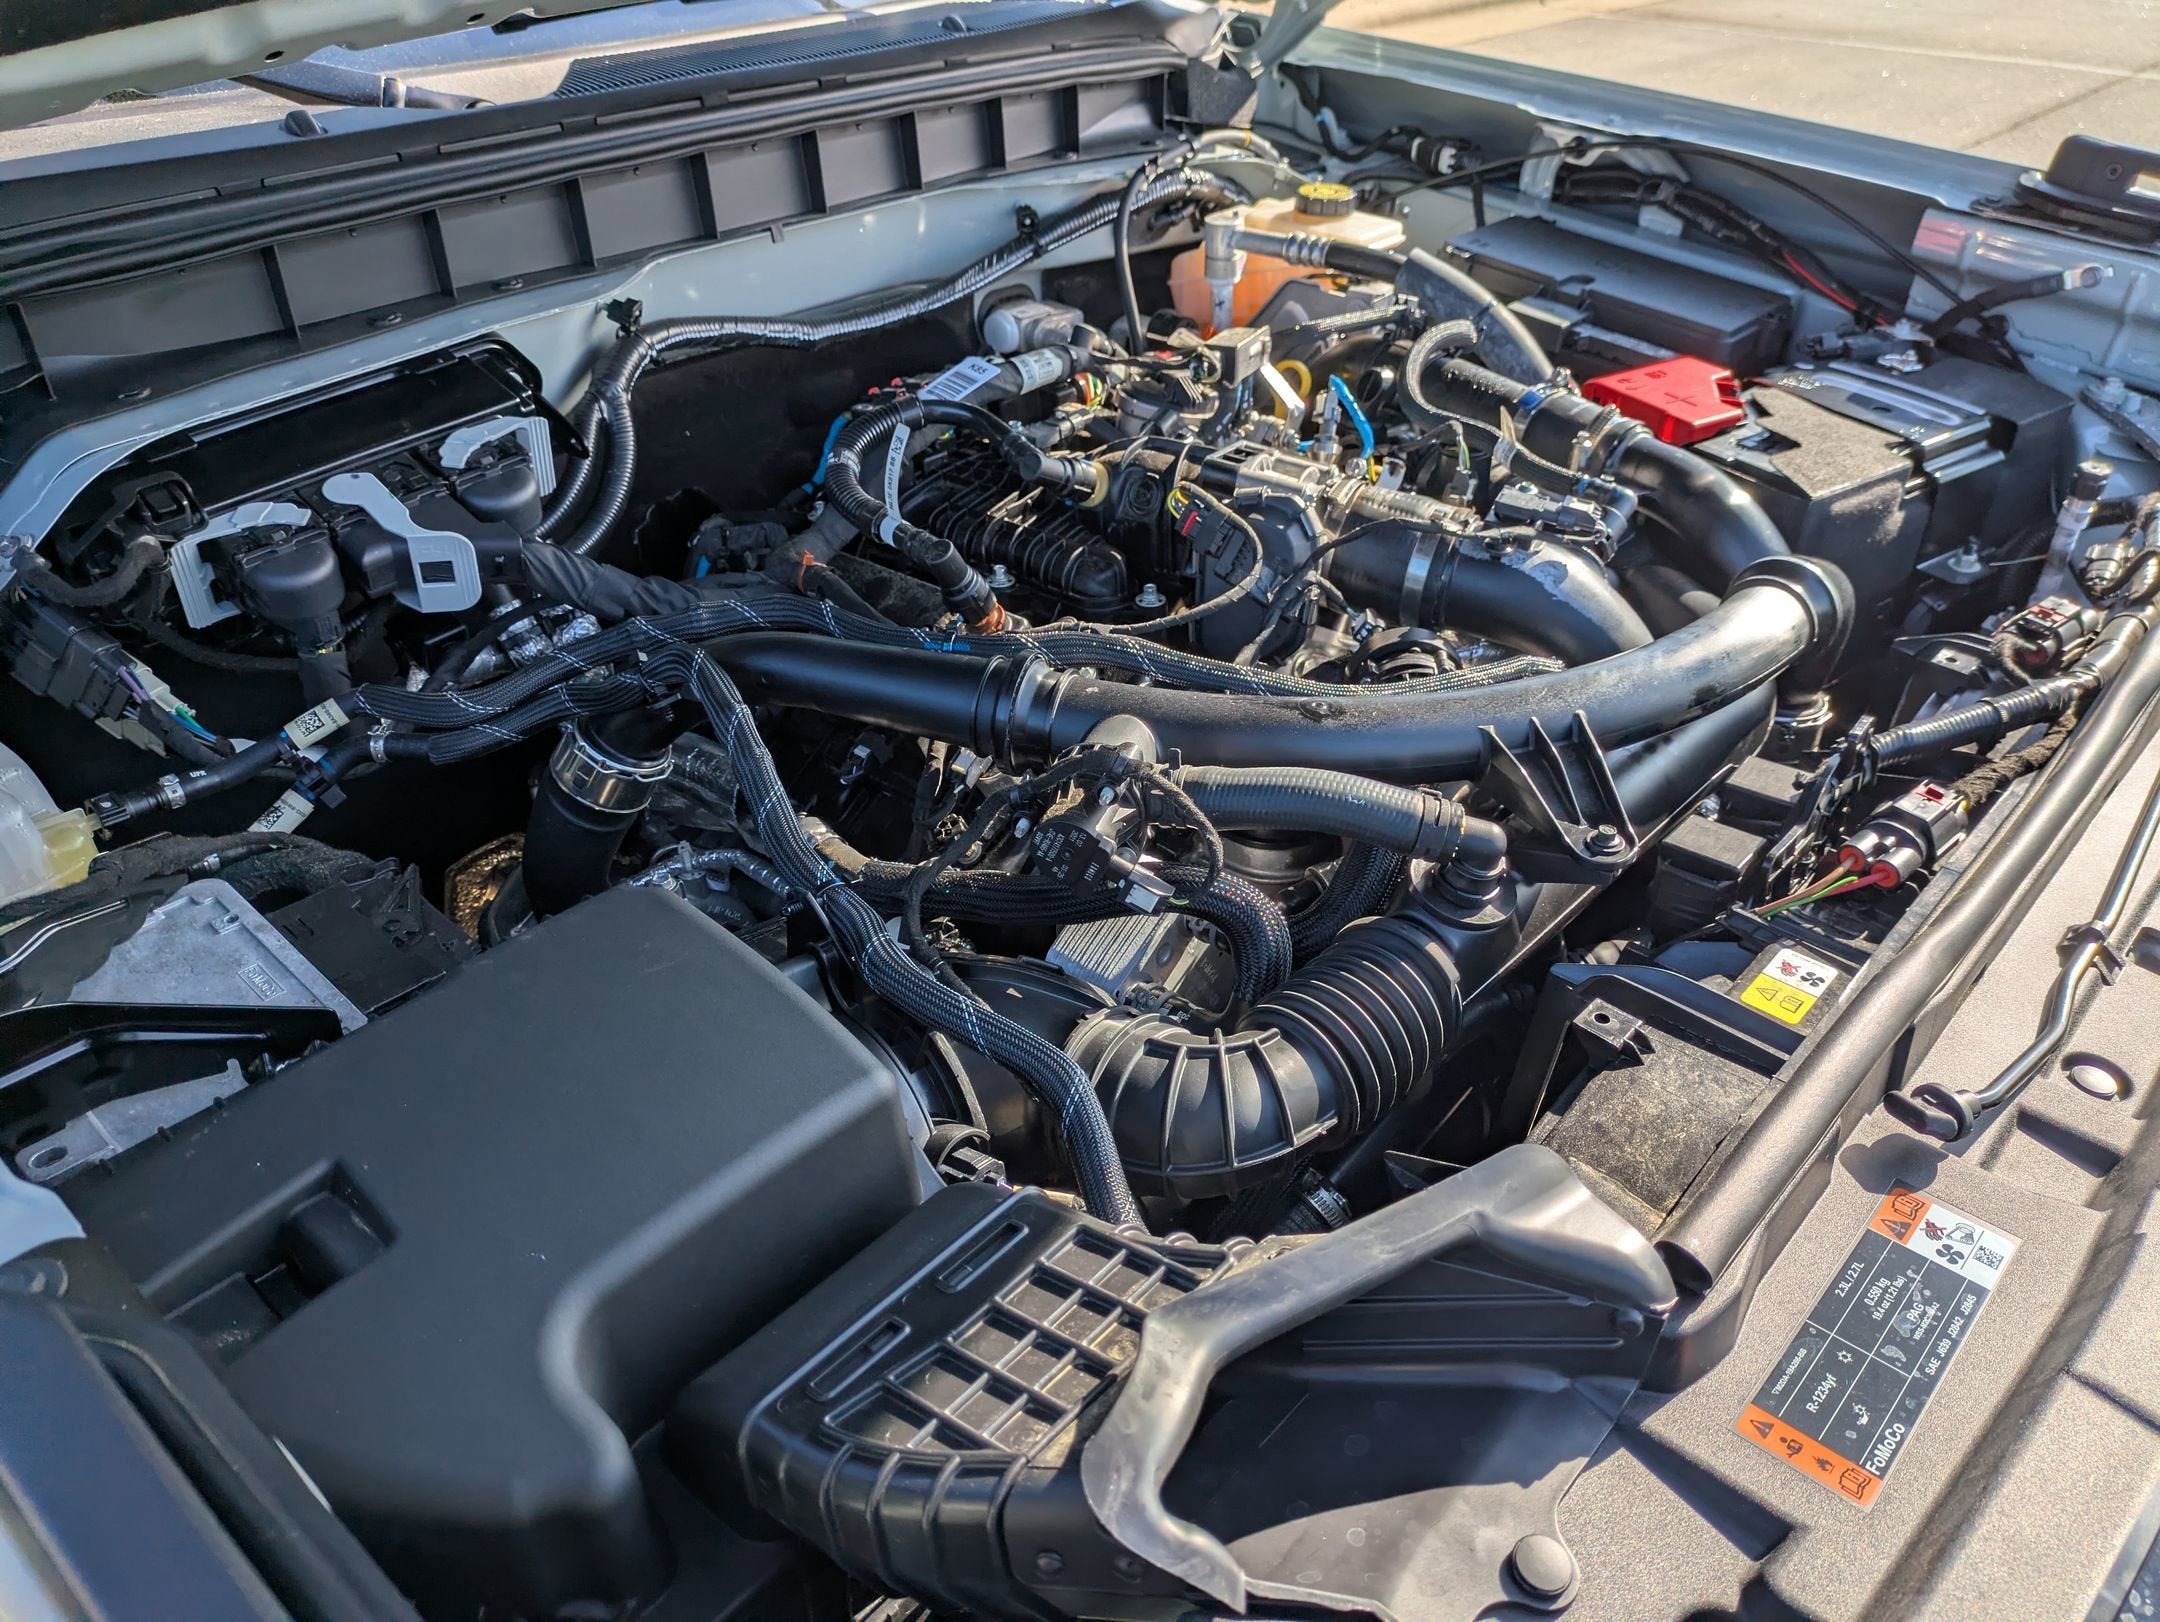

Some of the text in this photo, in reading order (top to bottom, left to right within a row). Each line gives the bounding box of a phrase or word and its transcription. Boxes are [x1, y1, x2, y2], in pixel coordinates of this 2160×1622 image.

[1835, 1279, 1852, 1298] 2.3L
[1848, 1262, 1864, 1280] 2.7L
[1864, 1278, 1891, 1308] 0.550 kg
[1872, 1307, 1885, 1321] 19.4
[1881, 1298, 1890, 1309] oz
[1907, 1303, 1925, 1322] PAG
[1925, 1294, 1977, 1376] SAE J639 J2842 J2845
[1806, 1373, 1837, 1413] R-1234yf
[1866, 1423, 1906, 1475] FoMoCo
